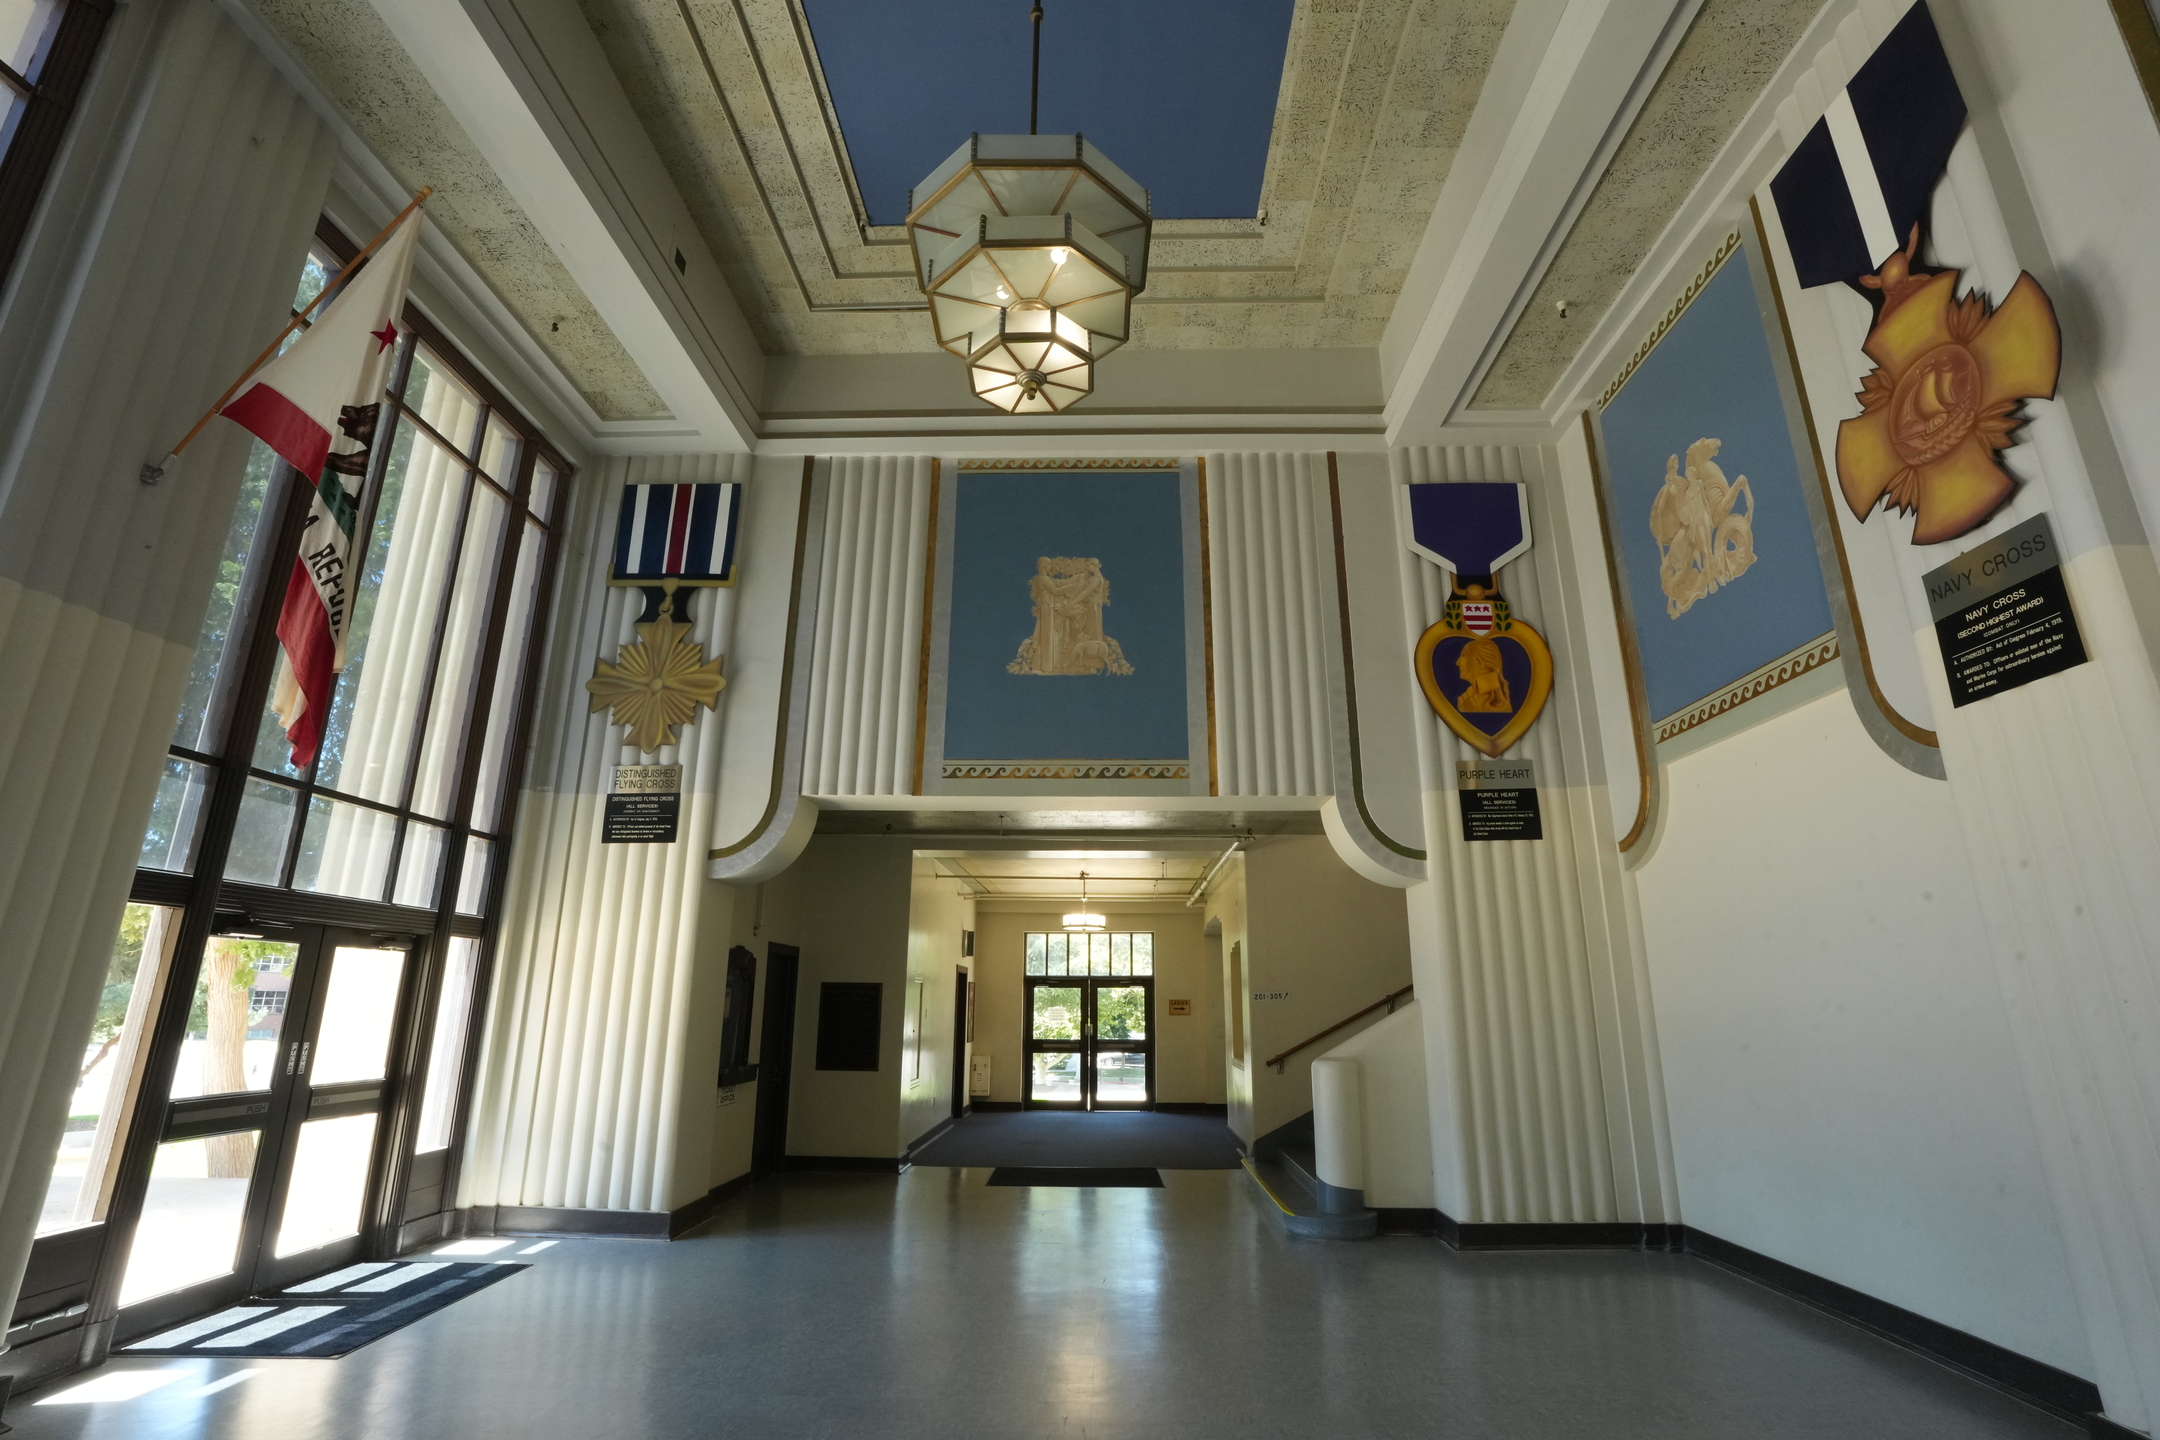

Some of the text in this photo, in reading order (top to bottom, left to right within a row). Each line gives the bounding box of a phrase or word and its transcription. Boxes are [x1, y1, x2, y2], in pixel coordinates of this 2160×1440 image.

[1931, 534, 2046, 603] NAVY CROSS
[1965, 588, 2026, 622] NAVY CROSS
[1957, 596, 2044, 640] (SECOND HIGHEST AWARD)
[615, 768, 677, 779] DISTINGUISHED
[1459, 768, 1530, 780] PURPLE HEART
[614, 779, 676, 789] FLYING CROSS
[313, 1096, 330, 1106] PUSH
[720, 1093, 735, 1103] OFFICE
[246, 1104, 266, 1114] PUSH
